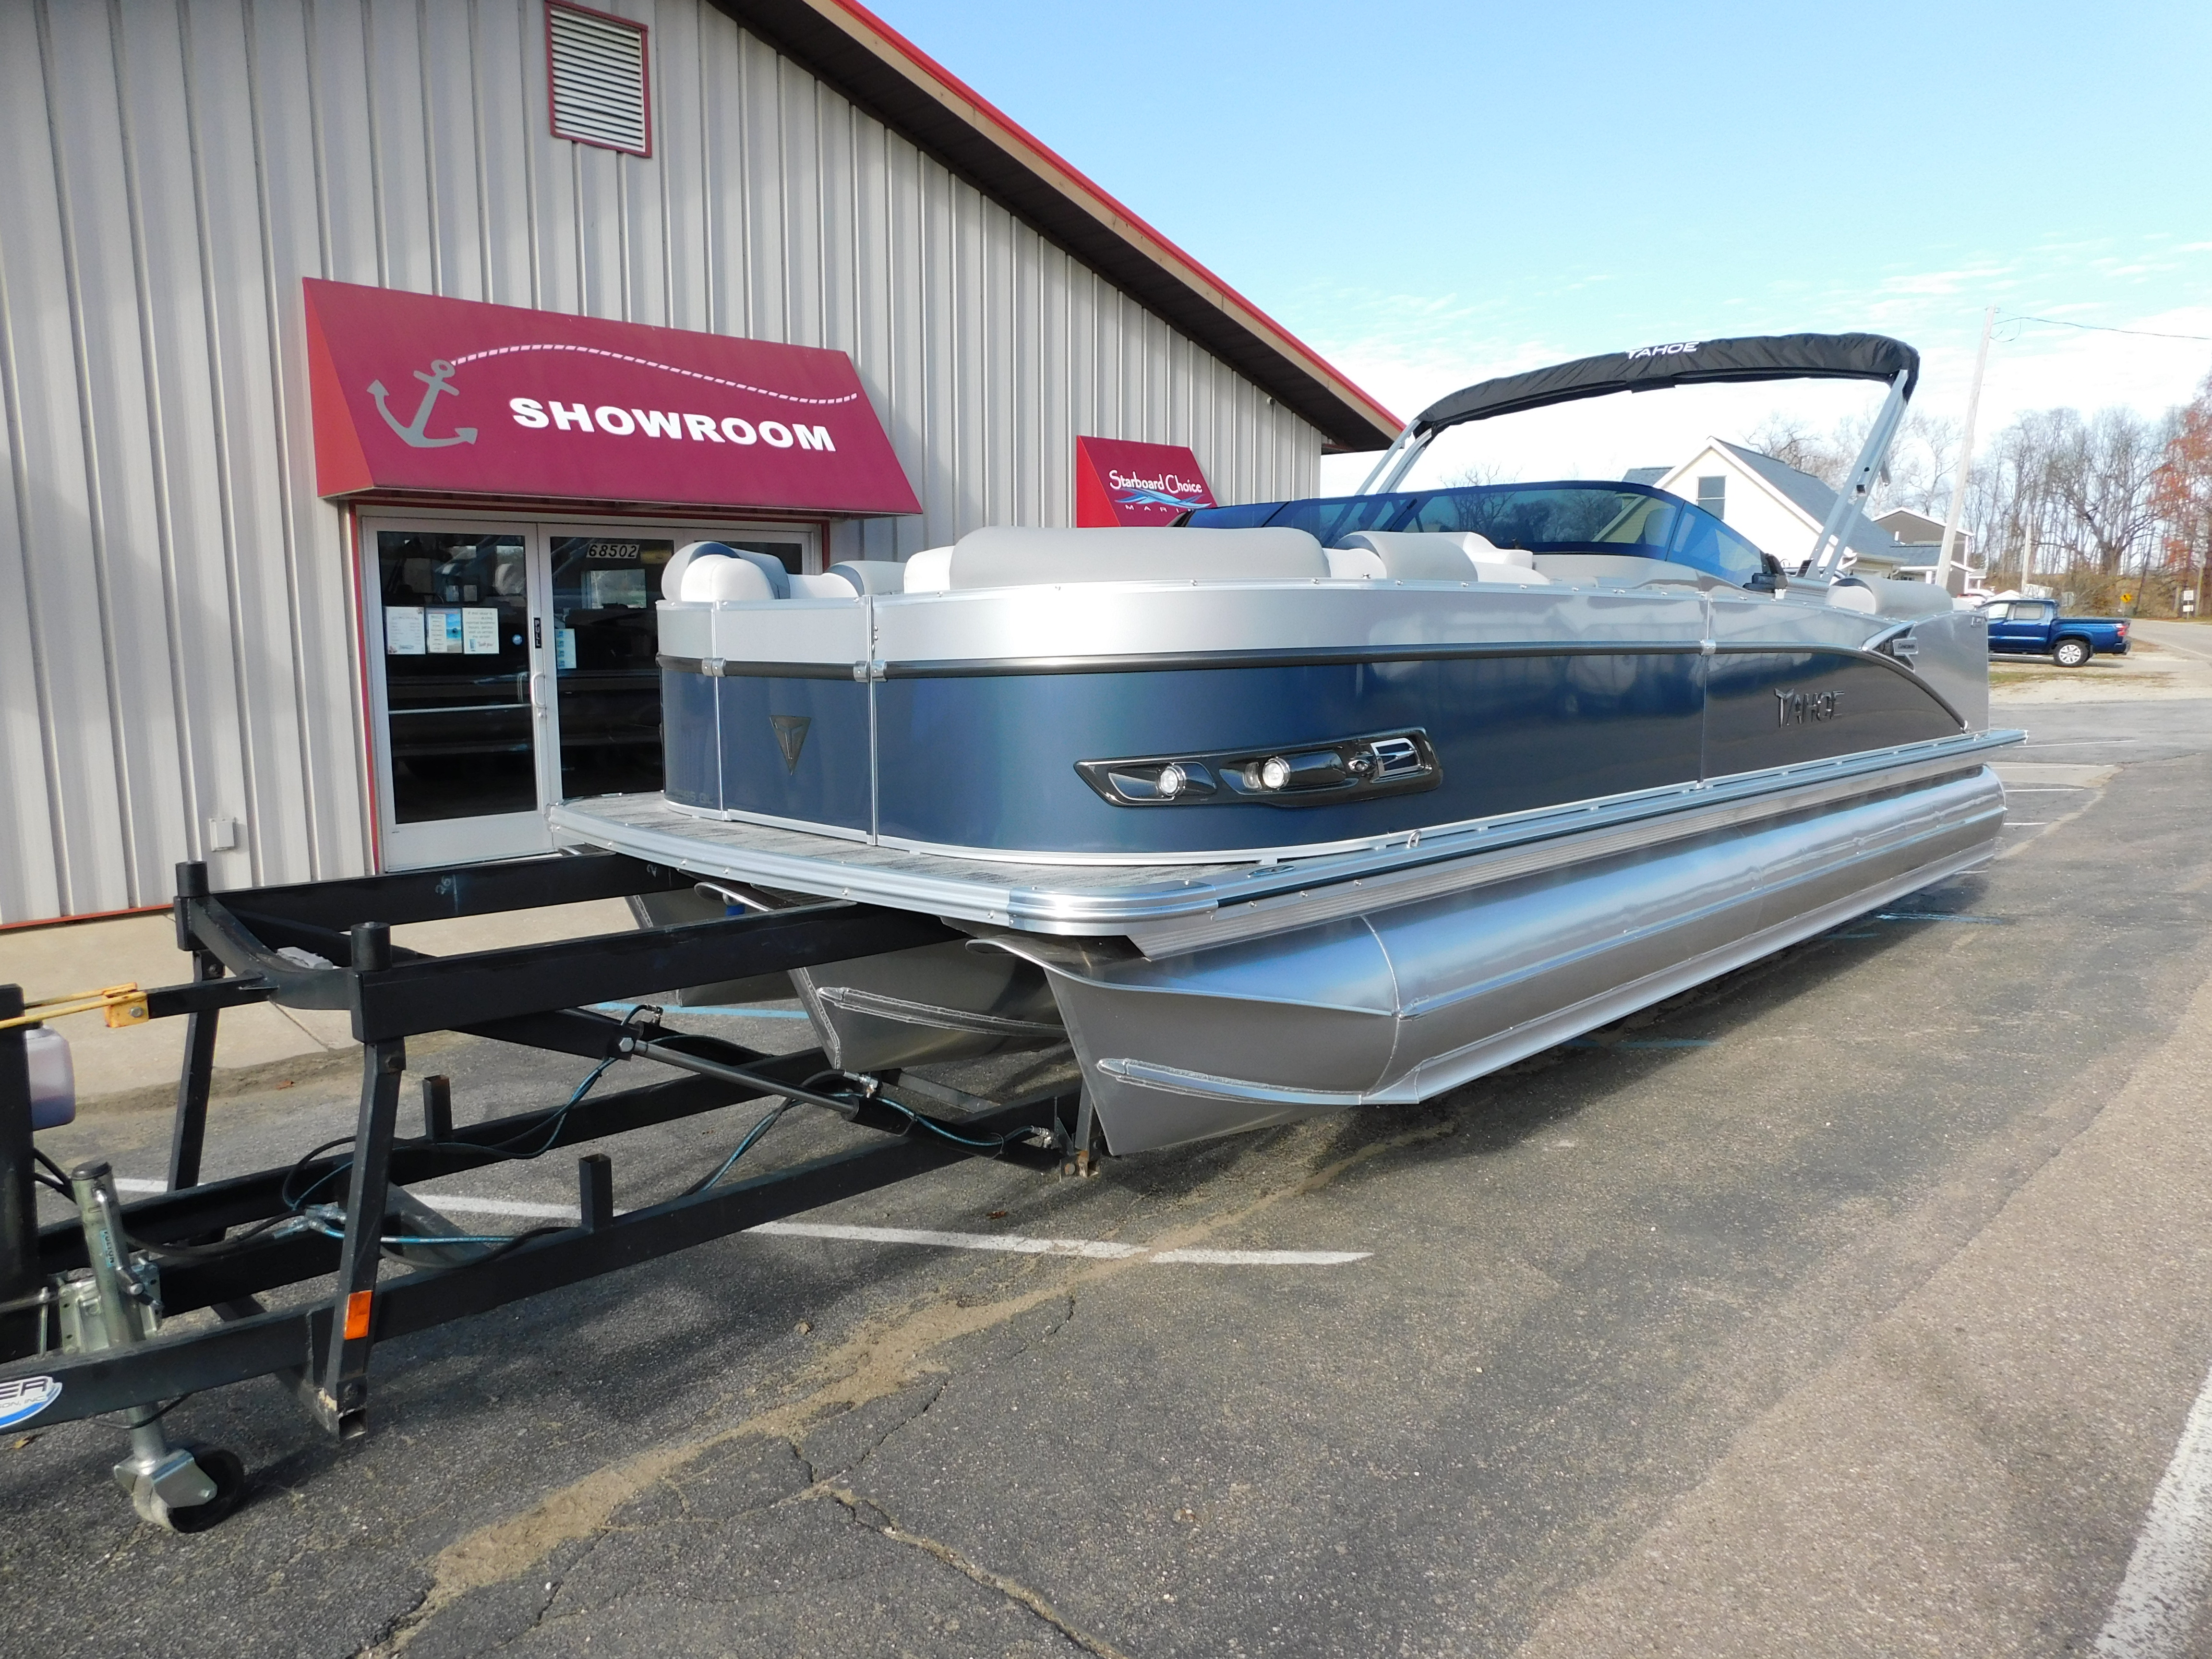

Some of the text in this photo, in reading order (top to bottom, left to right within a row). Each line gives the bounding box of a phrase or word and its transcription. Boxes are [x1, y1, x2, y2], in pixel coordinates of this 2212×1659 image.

[1625, 341, 1700, 360] TAHOE
[509, 397, 836, 452] SHOWROOM
[1109, 469, 1202, 493] Starboard Choice
[589, 544, 637, 557] 68502
[1774, 688, 1845, 728] TAHOE
